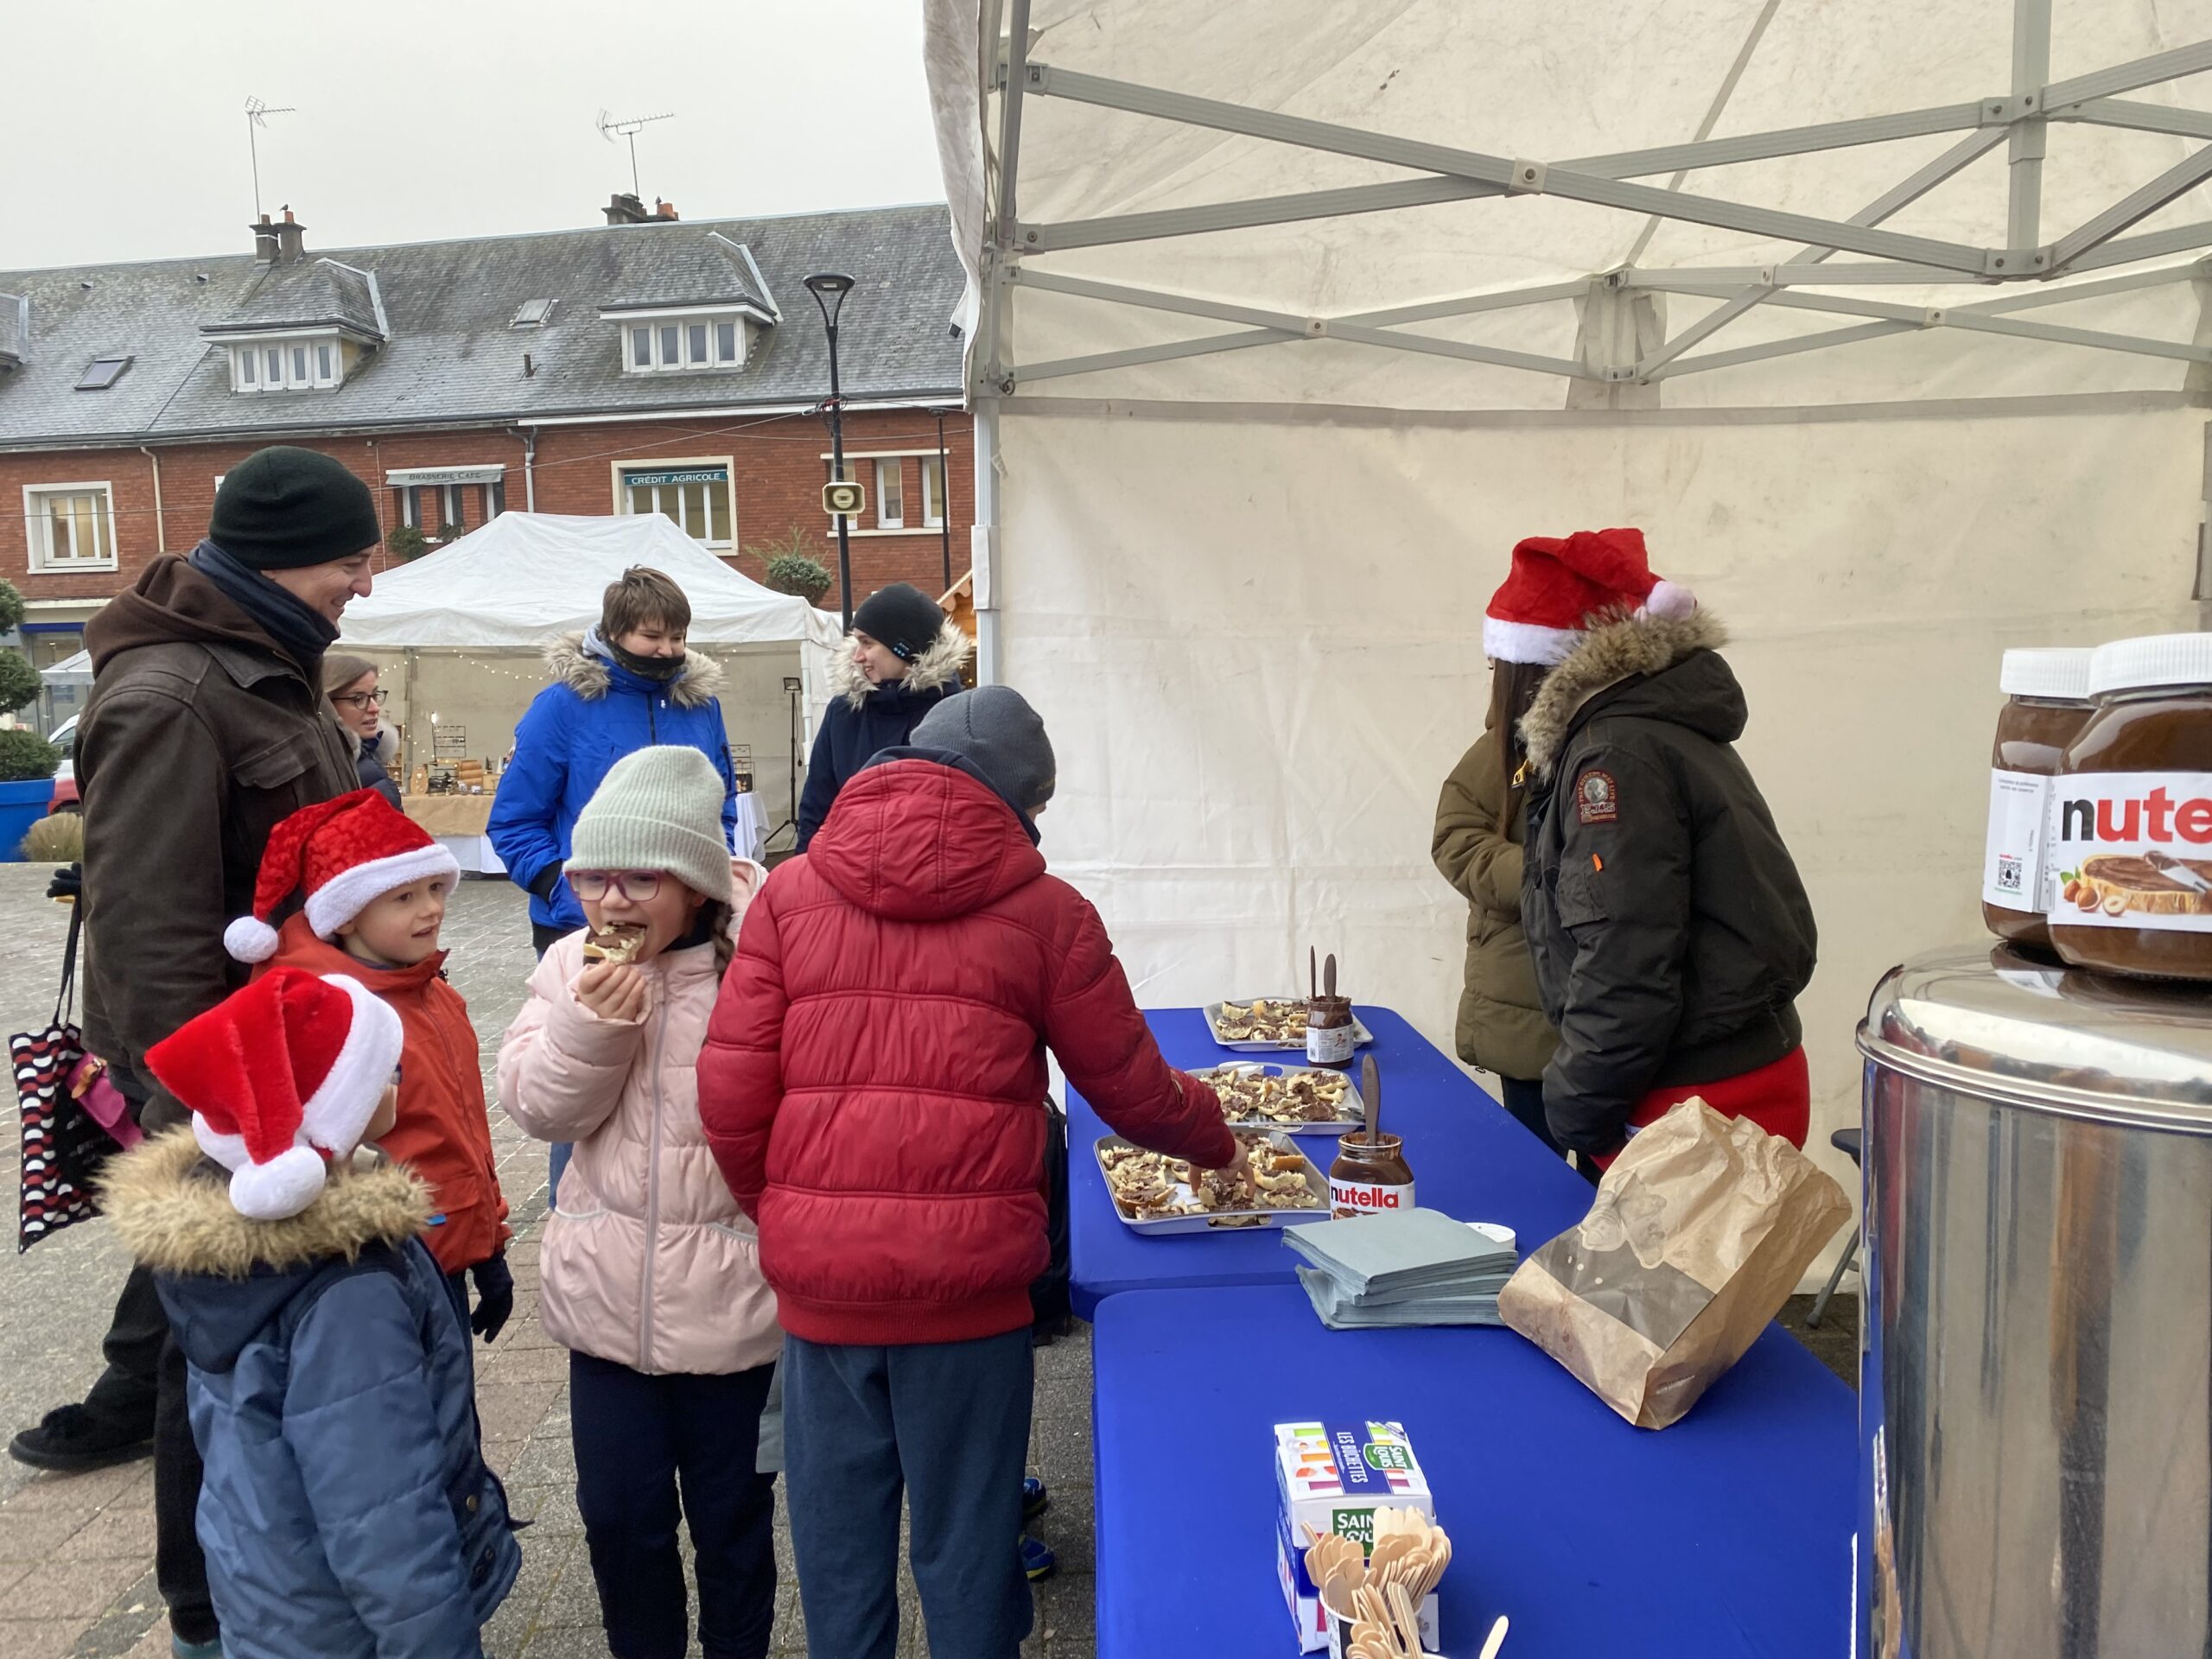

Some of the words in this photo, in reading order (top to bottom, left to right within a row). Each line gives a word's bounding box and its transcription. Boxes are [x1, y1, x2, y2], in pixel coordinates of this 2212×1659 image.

[410, 472, 454, 480] BRASSERIE
[632, 475, 667, 485] CRÉDIT
[671, 473, 720, 483] AGRICOLE
[2062, 786, 2212, 844] nute
[1331, 1185, 1399, 1208] nutella
[1336, 1432, 1355, 1444] LES
[1373, 1446, 1395, 1468] LOUIS
[1389, 1446, 1408, 1469] SAINT
[1338, 1513, 1373, 1529] SAIN
